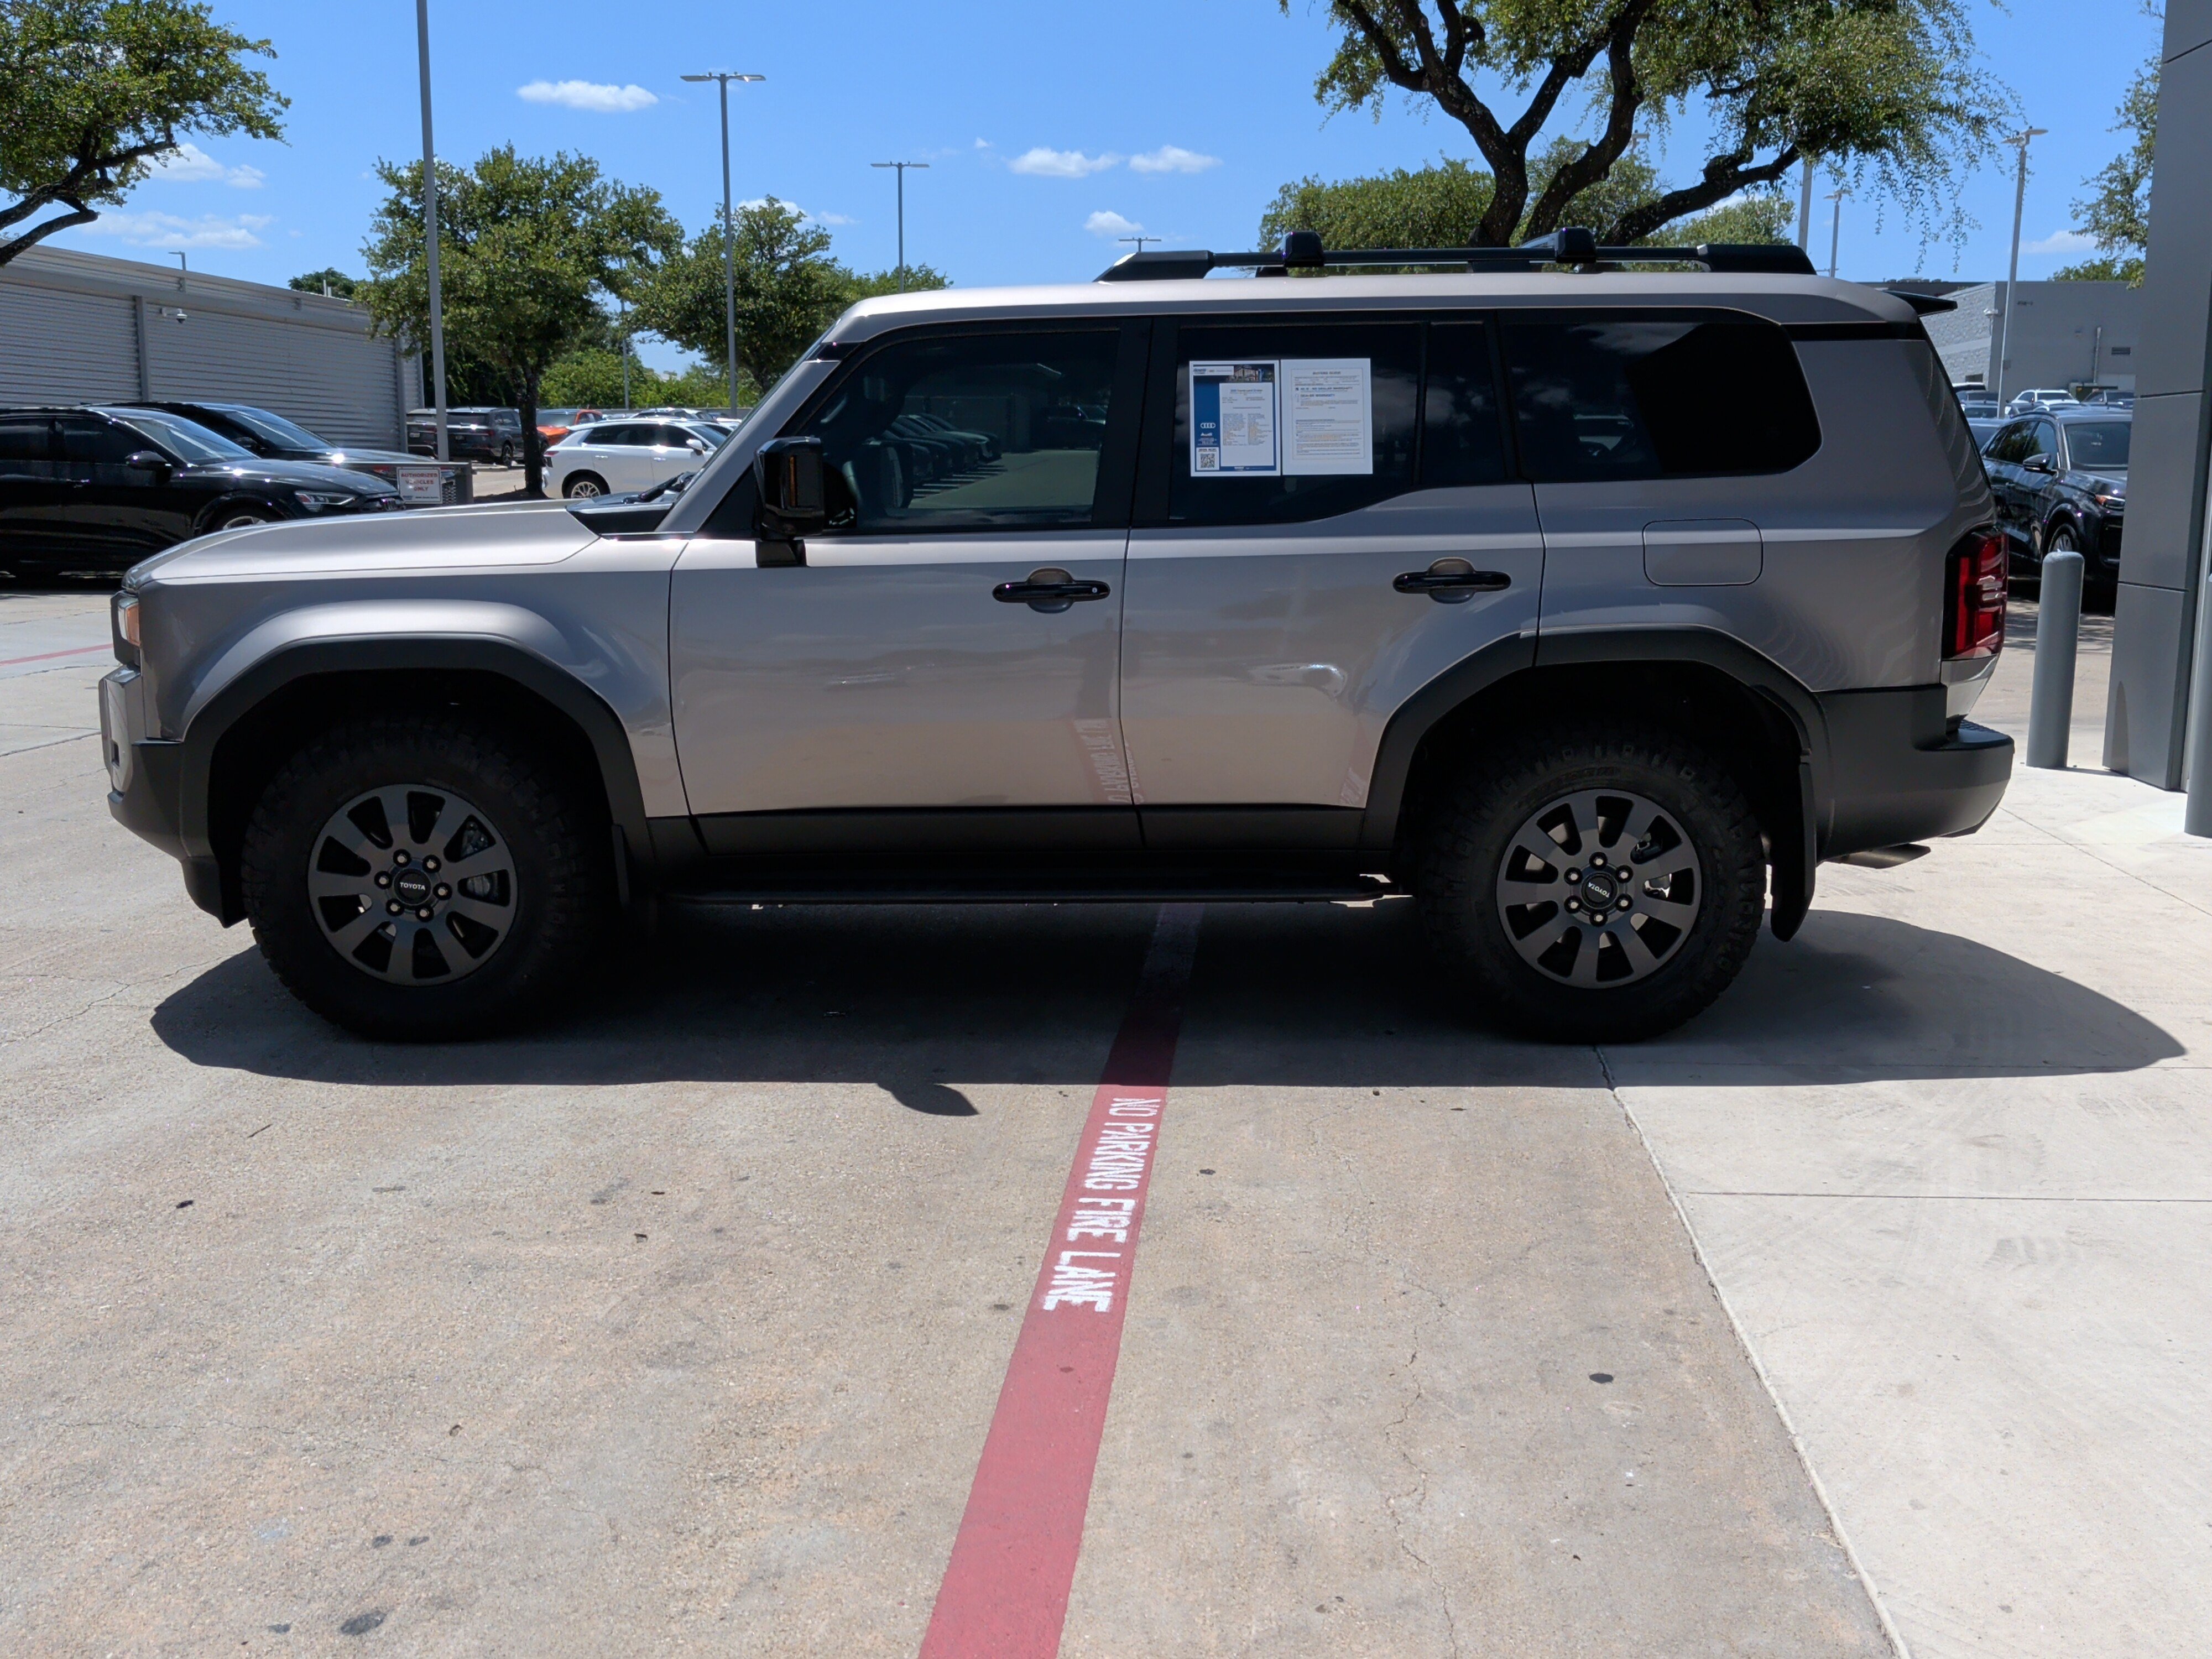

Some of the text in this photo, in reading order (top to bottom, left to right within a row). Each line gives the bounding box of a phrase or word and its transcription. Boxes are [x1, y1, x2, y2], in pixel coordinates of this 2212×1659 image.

[400, 882, 426, 890] TOYOTA
[1588, 882, 1610, 898] TOYOTA
[1042, 1097, 1161, 1313] NO PARKING FIRE LANE
